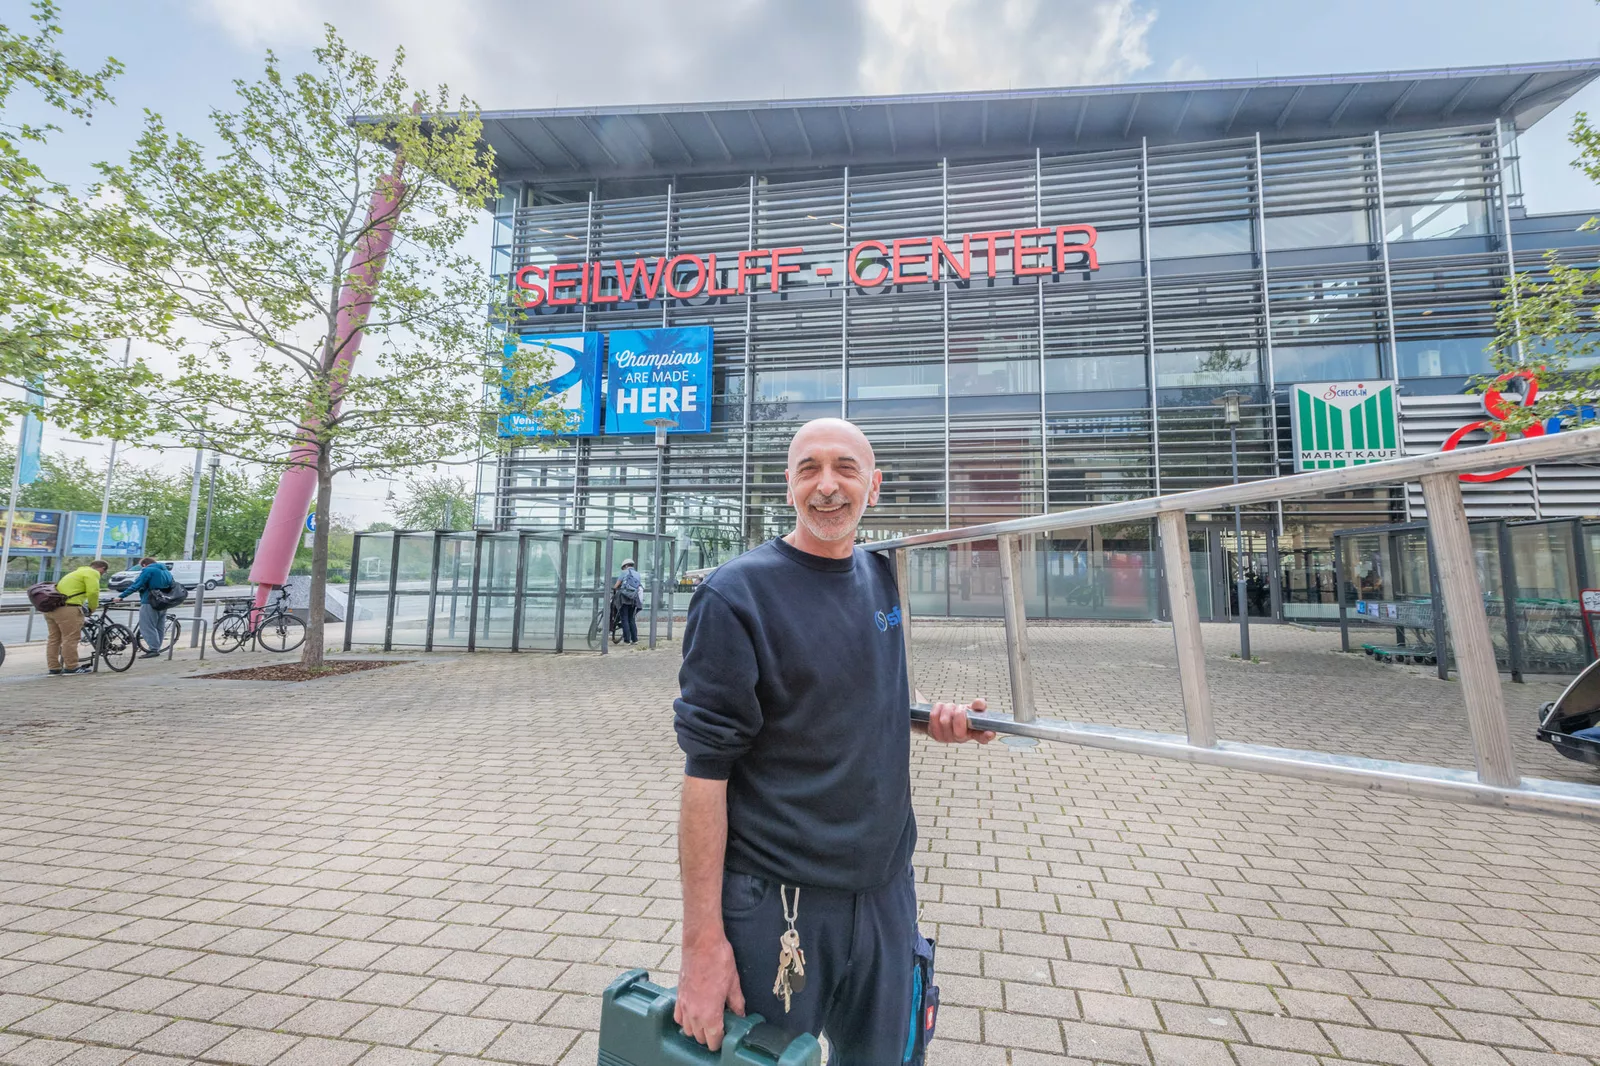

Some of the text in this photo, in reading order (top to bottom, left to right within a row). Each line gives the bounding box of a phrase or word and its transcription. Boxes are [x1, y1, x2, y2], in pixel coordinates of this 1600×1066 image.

[515, 247, 803, 309] SEILWOLFF
[848, 224, 1100, 288] CENTER
[615, 350, 702, 369] Champions
[625, 370, 689, 384] ARE MADE
[616, 385, 698, 414] HERE
[1301, 450, 1397, 460] MARKTKAUF
